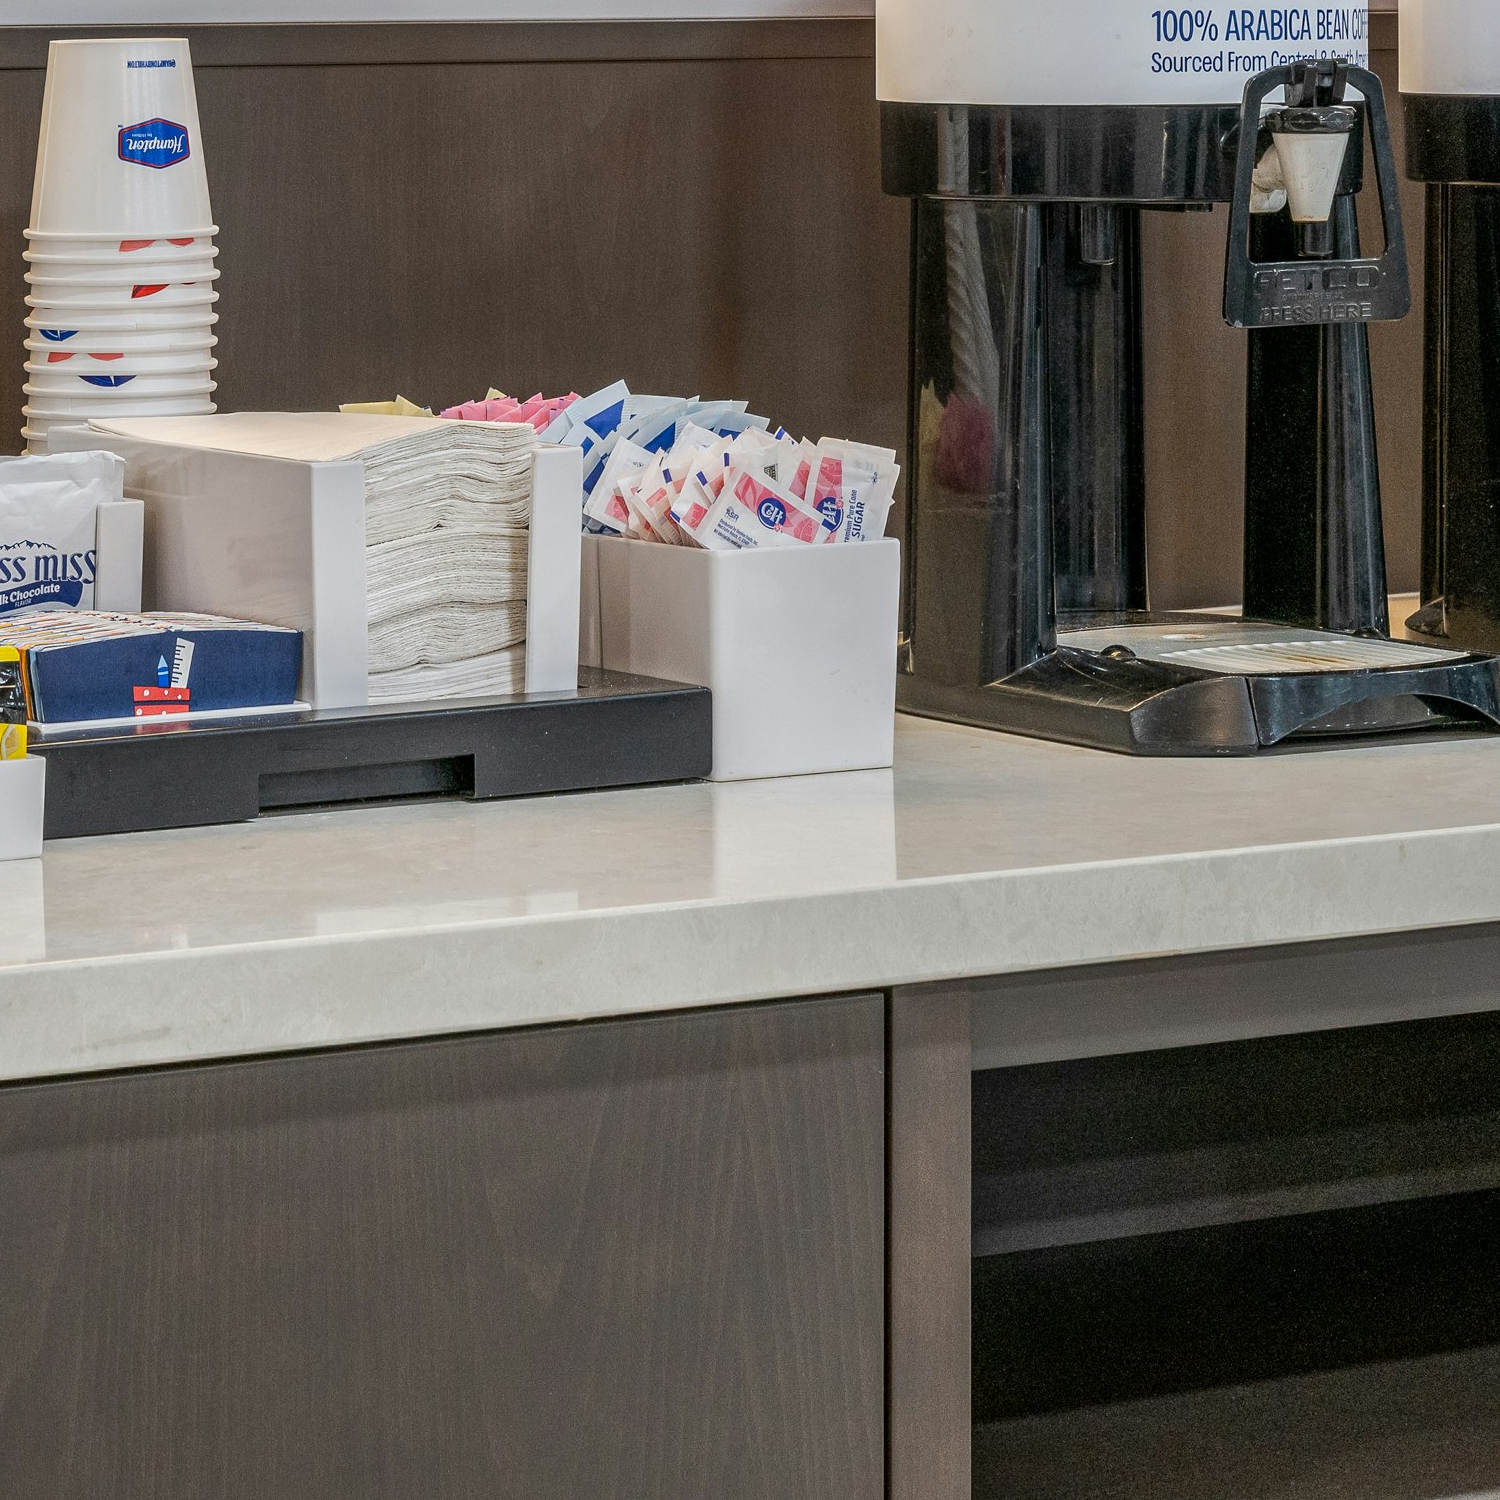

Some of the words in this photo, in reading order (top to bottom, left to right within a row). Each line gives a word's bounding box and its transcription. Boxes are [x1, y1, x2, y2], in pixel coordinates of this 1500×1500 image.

[1151, 9, 1218, 42] 100%
[1225, 9, 1311, 41] ARABICA
[1317, 9, 1349, 40] BEAN
[1151, 51, 1223, 73] Sourced
[1228, 51, 1267, 72] From
[126, 134, 185, 154] Hampton
[760, 502, 784, 524] C&H
[852, 502, 865, 538] SUGAR
[844, 520, 852, 543] remium
[10, 583, 60, 602] Chocolate
